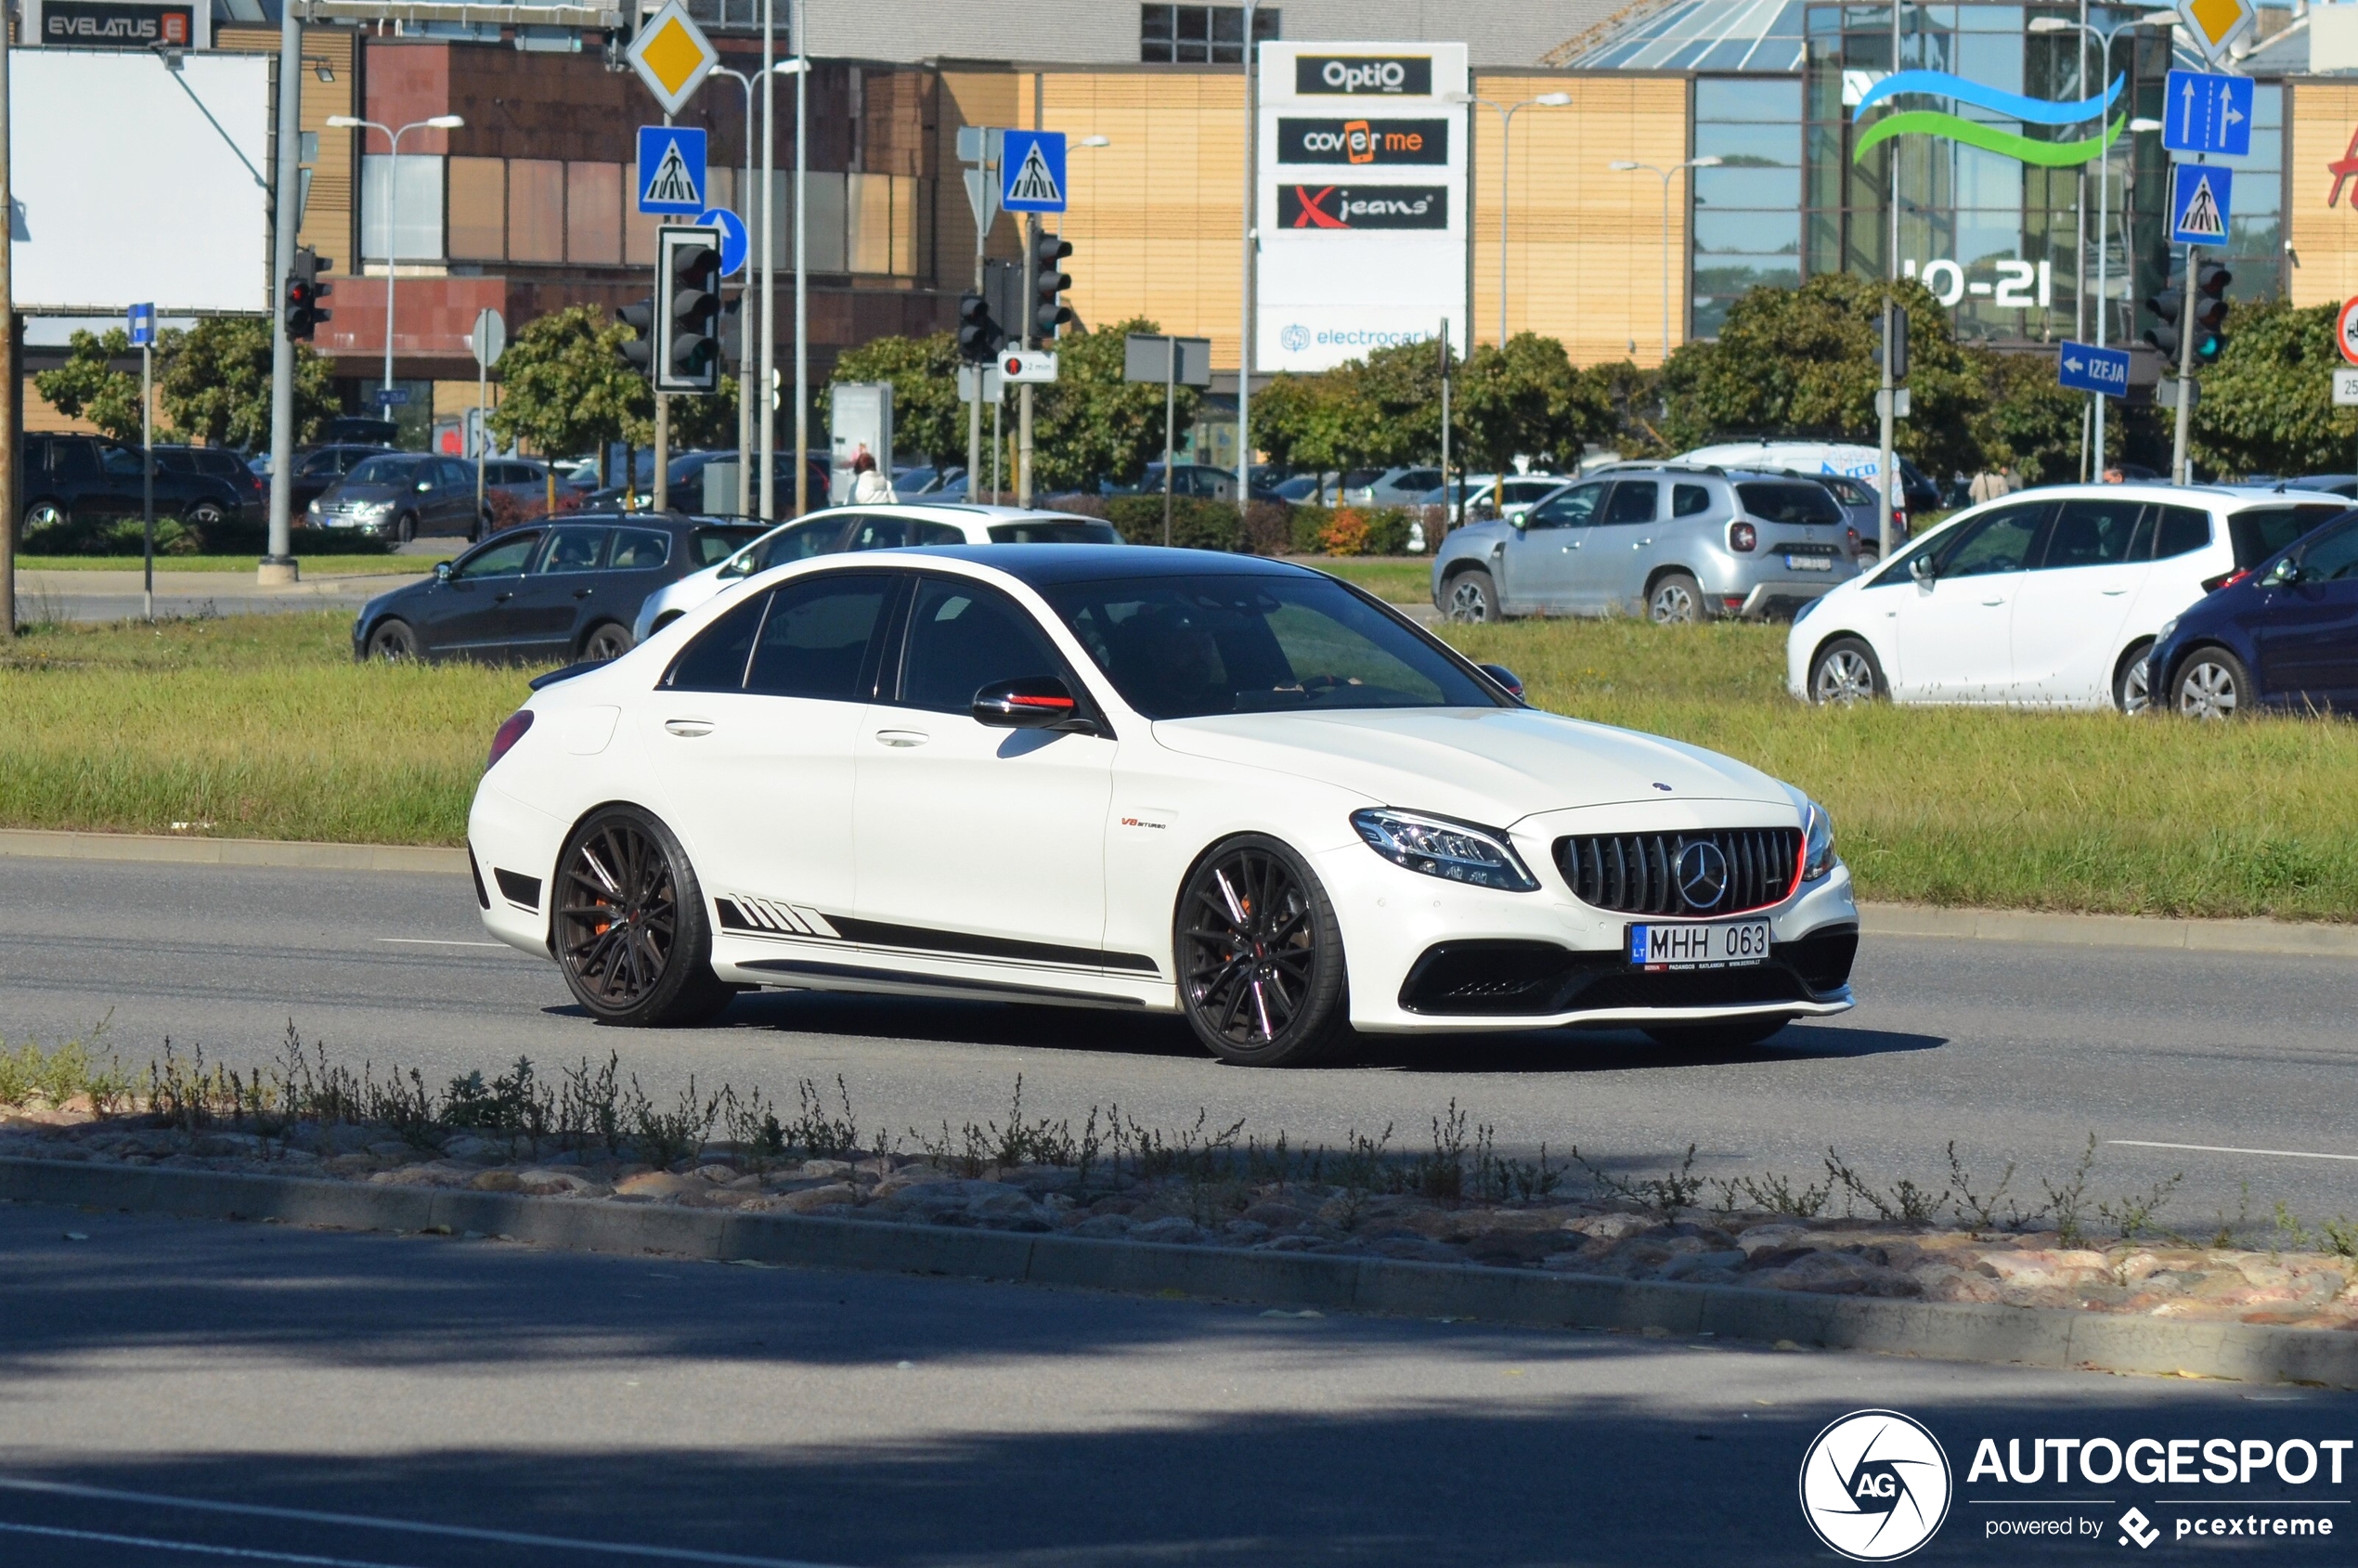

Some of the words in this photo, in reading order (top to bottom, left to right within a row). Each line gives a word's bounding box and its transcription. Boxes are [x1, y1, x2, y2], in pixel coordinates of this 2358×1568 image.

[48, 16, 157, 37] EVELATUS
[1322, 60, 1405, 92] OptiO
[1302, 131, 1381, 152] cover
[1385, 133, 1423, 151] me
[2088, 358, 2125, 383] IZEJA
[1633, 948, 1645, 957] LT
[1651, 927, 1709, 959] MHH
[1726, 925, 1765, 956] 063
